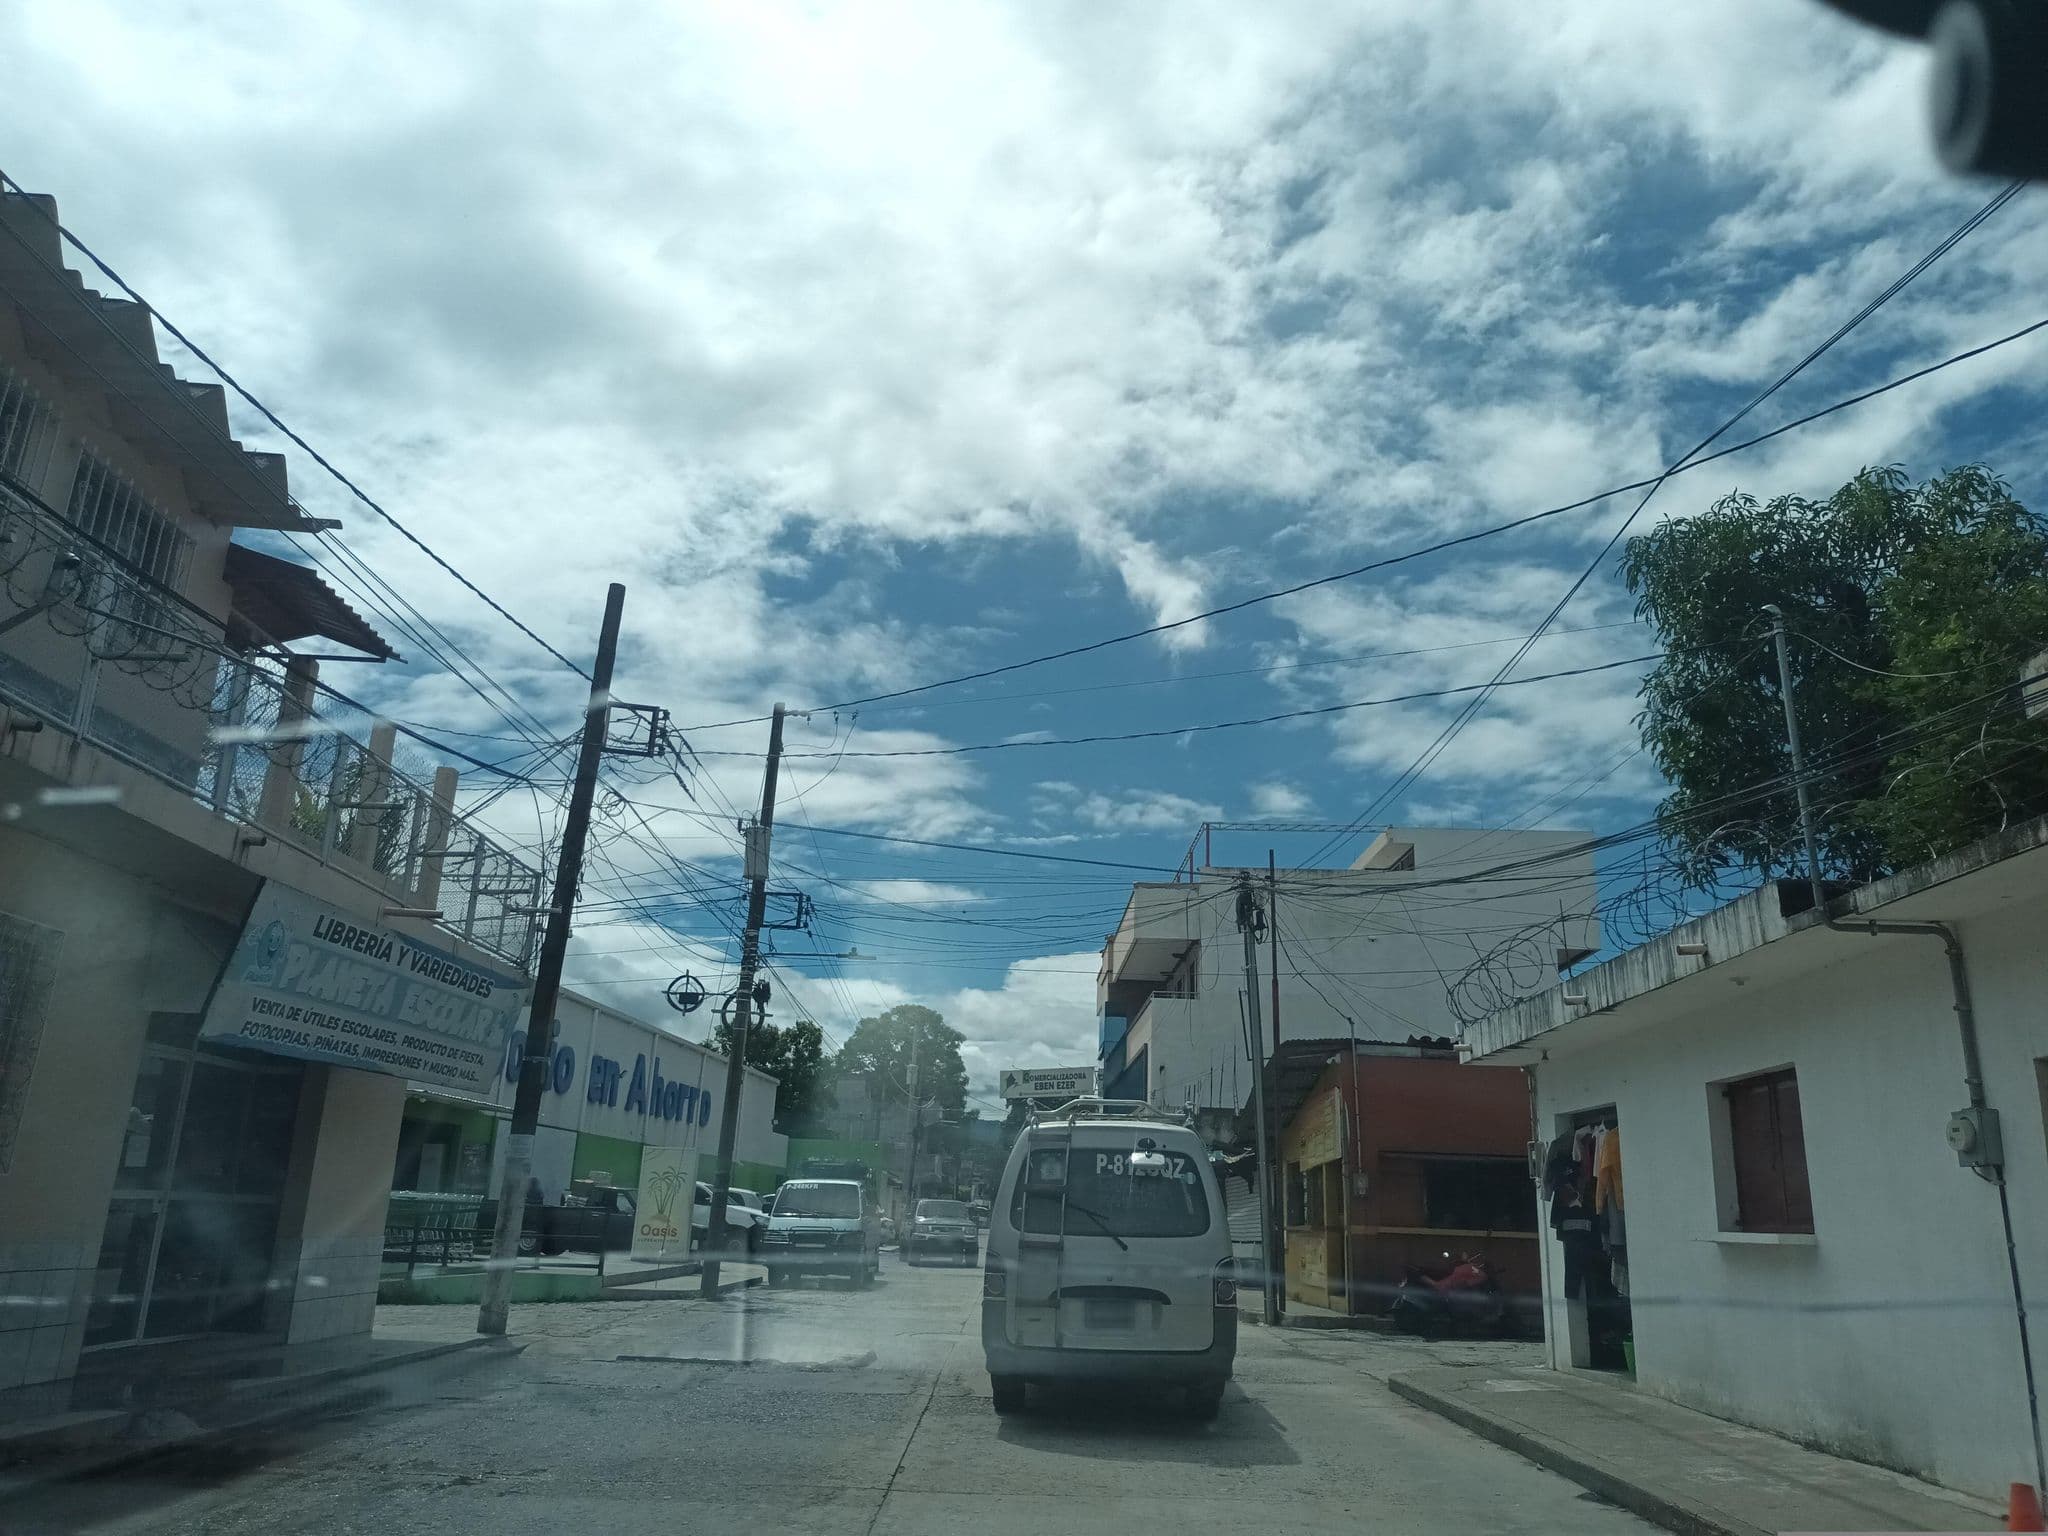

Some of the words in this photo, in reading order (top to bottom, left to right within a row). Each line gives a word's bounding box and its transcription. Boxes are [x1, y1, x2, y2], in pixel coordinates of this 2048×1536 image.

[279, 943, 397, 1017] PLANETA
[312, 914, 394, 962] LIBRERÍA
[397, 945, 410, 966] Y
[409, 951, 494, 998] VARIEDADES
[240, 1020, 312, 1048] FOTOCOPIAS,
[313, 1035, 360, 1057] PIÑATAS,
[361, 1046, 422, 1070] IMPRESIONES
[422, 1060, 430, 1071] Y
[429, 1062, 459, 1077] MUCHO
[252, 997, 285, 1020] VENTA
[285, 1006, 302, 1021] DE
[303, 1008, 341, 1030] ÚTILES
[341, 1020, 397, 1045] ESCOLARES,
[401, 1035, 448, 1056] PRODUCTO
[447, 1048, 460, 1060] DE
[587, 1055, 620, 1107] en
[624, 1053, 711, 1127] Ahorro
[1023, 1071, 1087, 1083] COMERCIALIZADORA
[1034, 1081, 1055, 1090] EBEN
[1057, 1080, 1076, 1089] EZER
[640, 1223, 678, 1237] Oasis
